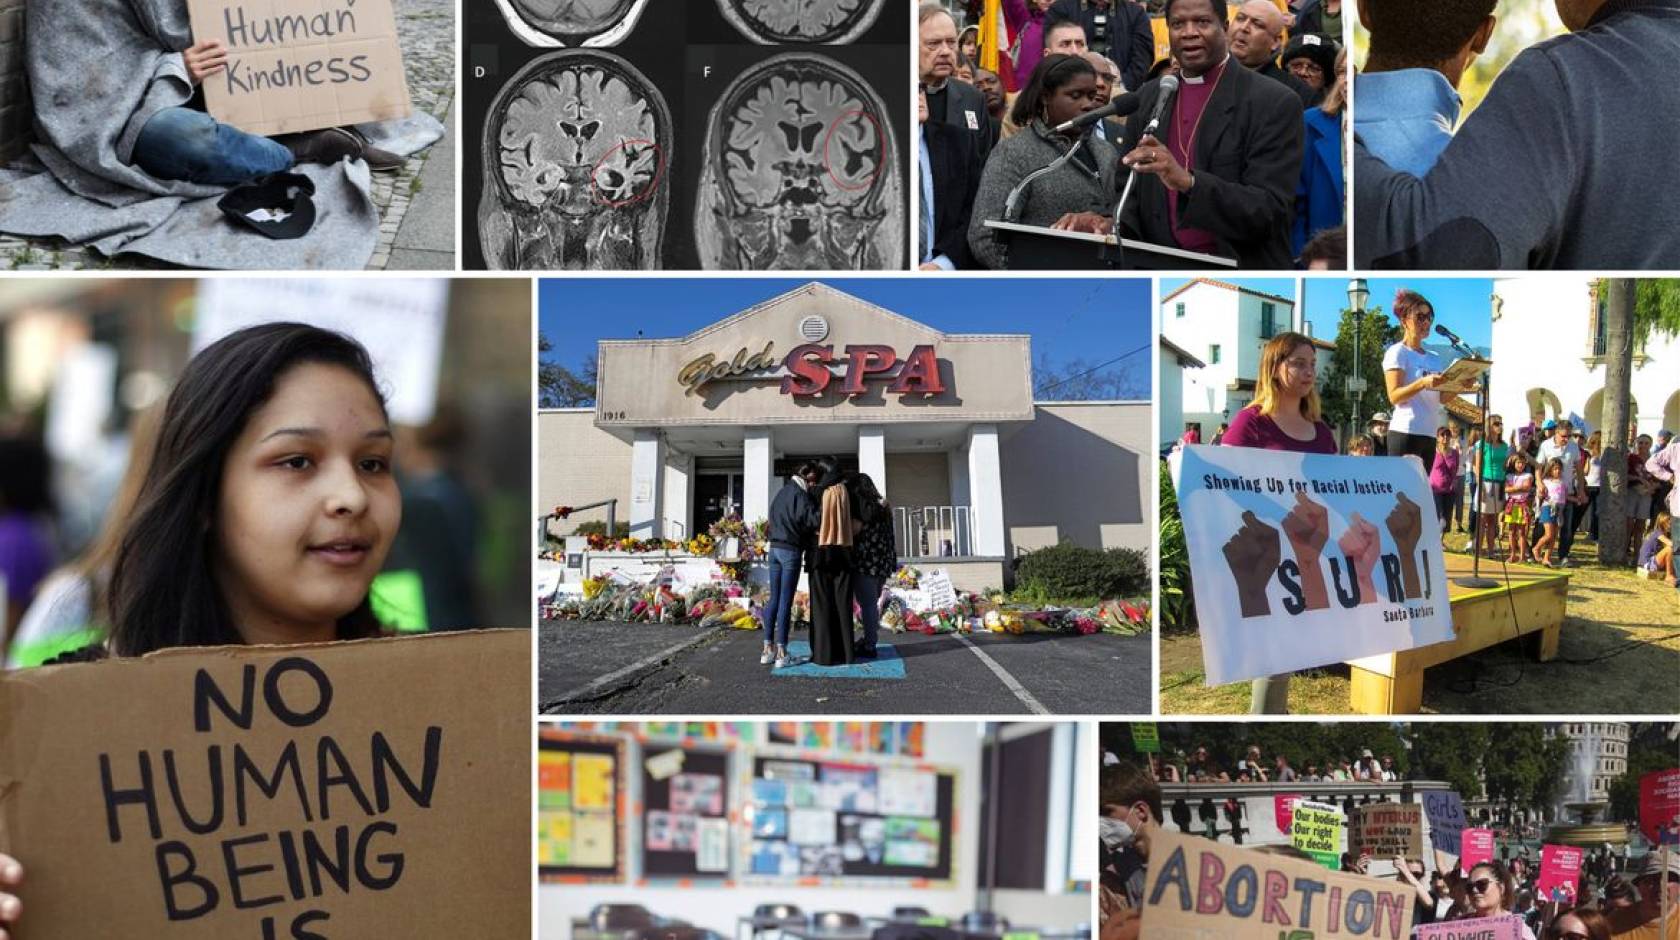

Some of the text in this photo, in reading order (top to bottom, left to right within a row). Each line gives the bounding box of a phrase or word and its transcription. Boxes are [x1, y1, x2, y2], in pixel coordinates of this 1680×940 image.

[223, 6, 356, 46] Human
[223, 55, 371, 95] Kindness
[677, 340, 945, 398] Gold SPA
[603, 411, 626, 421] 1916
[1203, 474, 1393, 495] Showing Up for Racial Justice
[1383, 606, 1434, 623] Santa Barbara
[194, 656, 334, 732] NO
[99, 726, 442, 843] HUMAN
[1294, 809, 1340, 827] Our bodies
[1294, 822, 1333, 841] Our right
[1294, 836, 1333, 851] to decide
[155, 821, 405, 921] BEING
[1148, 845, 1405, 940] ABORTION
